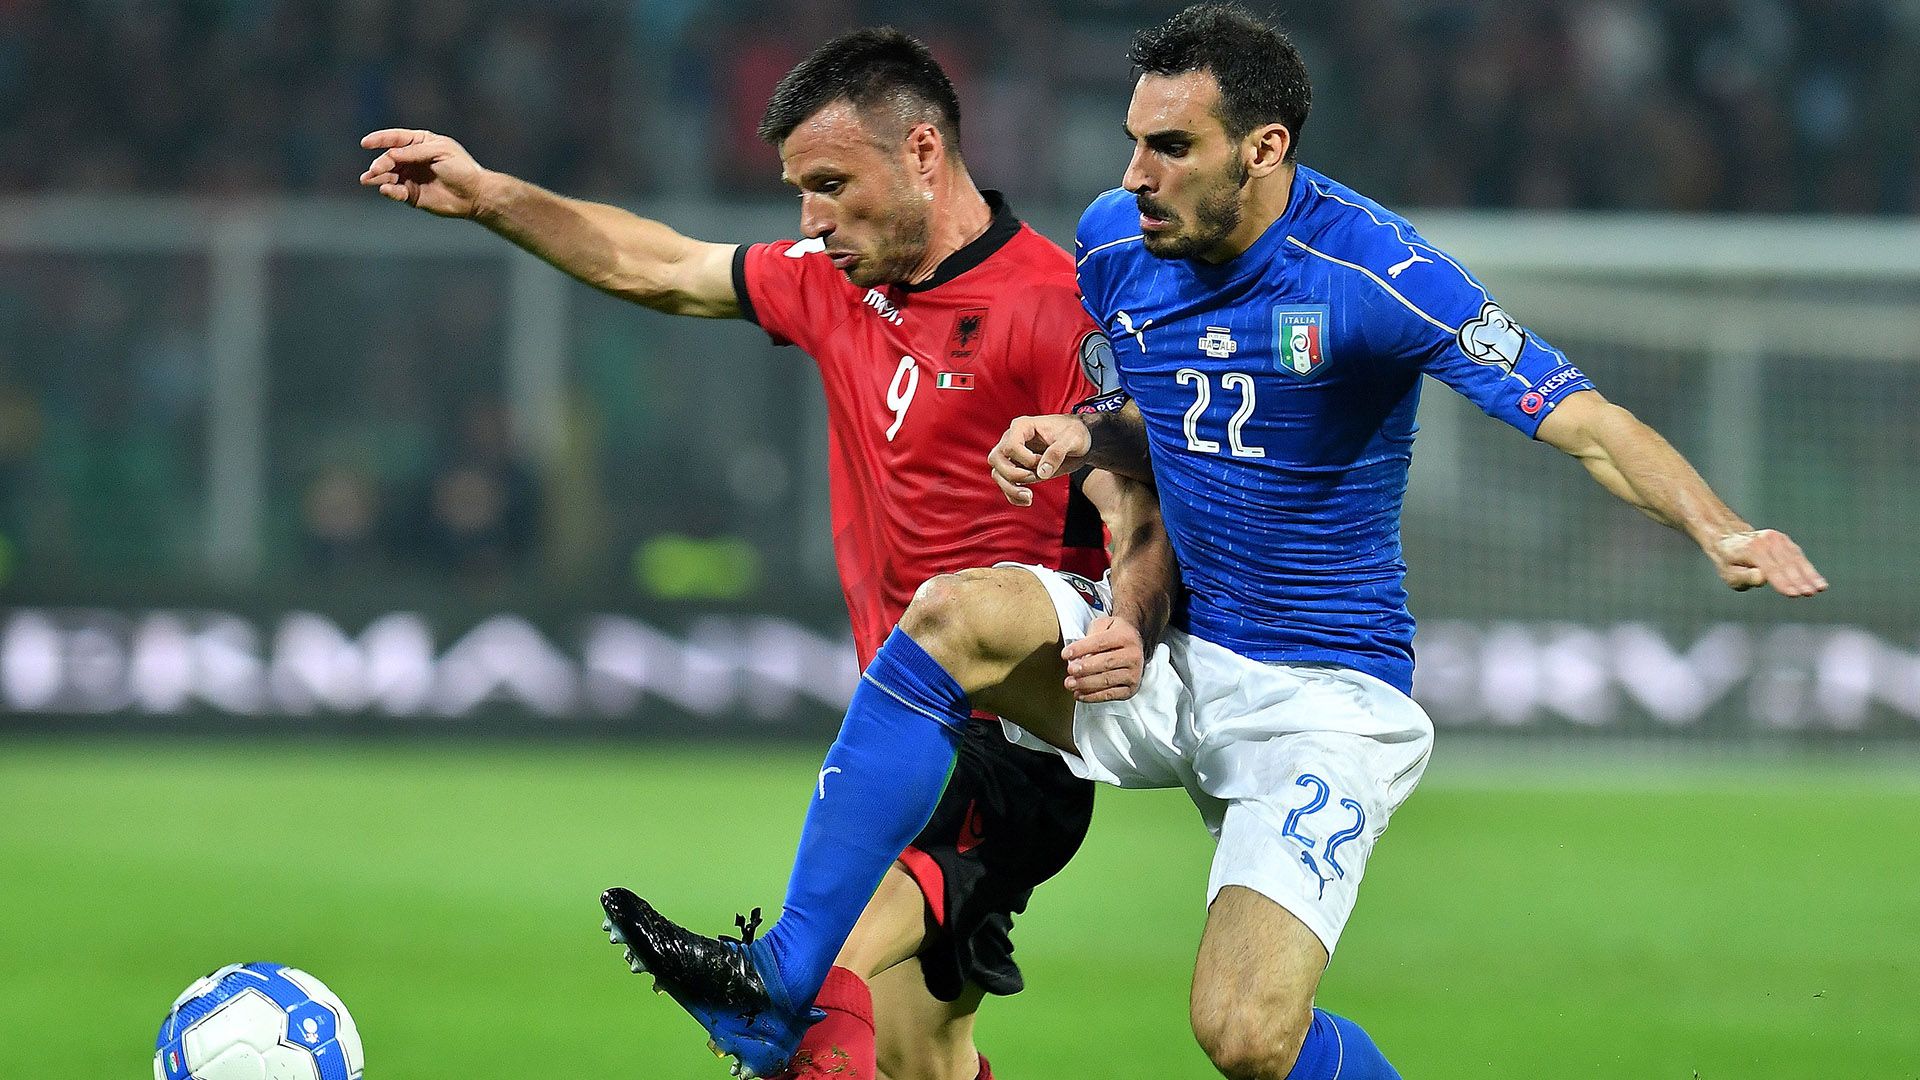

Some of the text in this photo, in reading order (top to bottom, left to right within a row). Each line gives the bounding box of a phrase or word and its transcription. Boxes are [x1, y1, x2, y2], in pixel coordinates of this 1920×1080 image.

[1200, 339, 1236, 352] ITA ALB
[1285, 316, 1316, 325] ITALIA
[885, 355, 920, 443] 9
[1175, 368, 1266, 458] 22
[1281, 773, 1366, 880] 22
